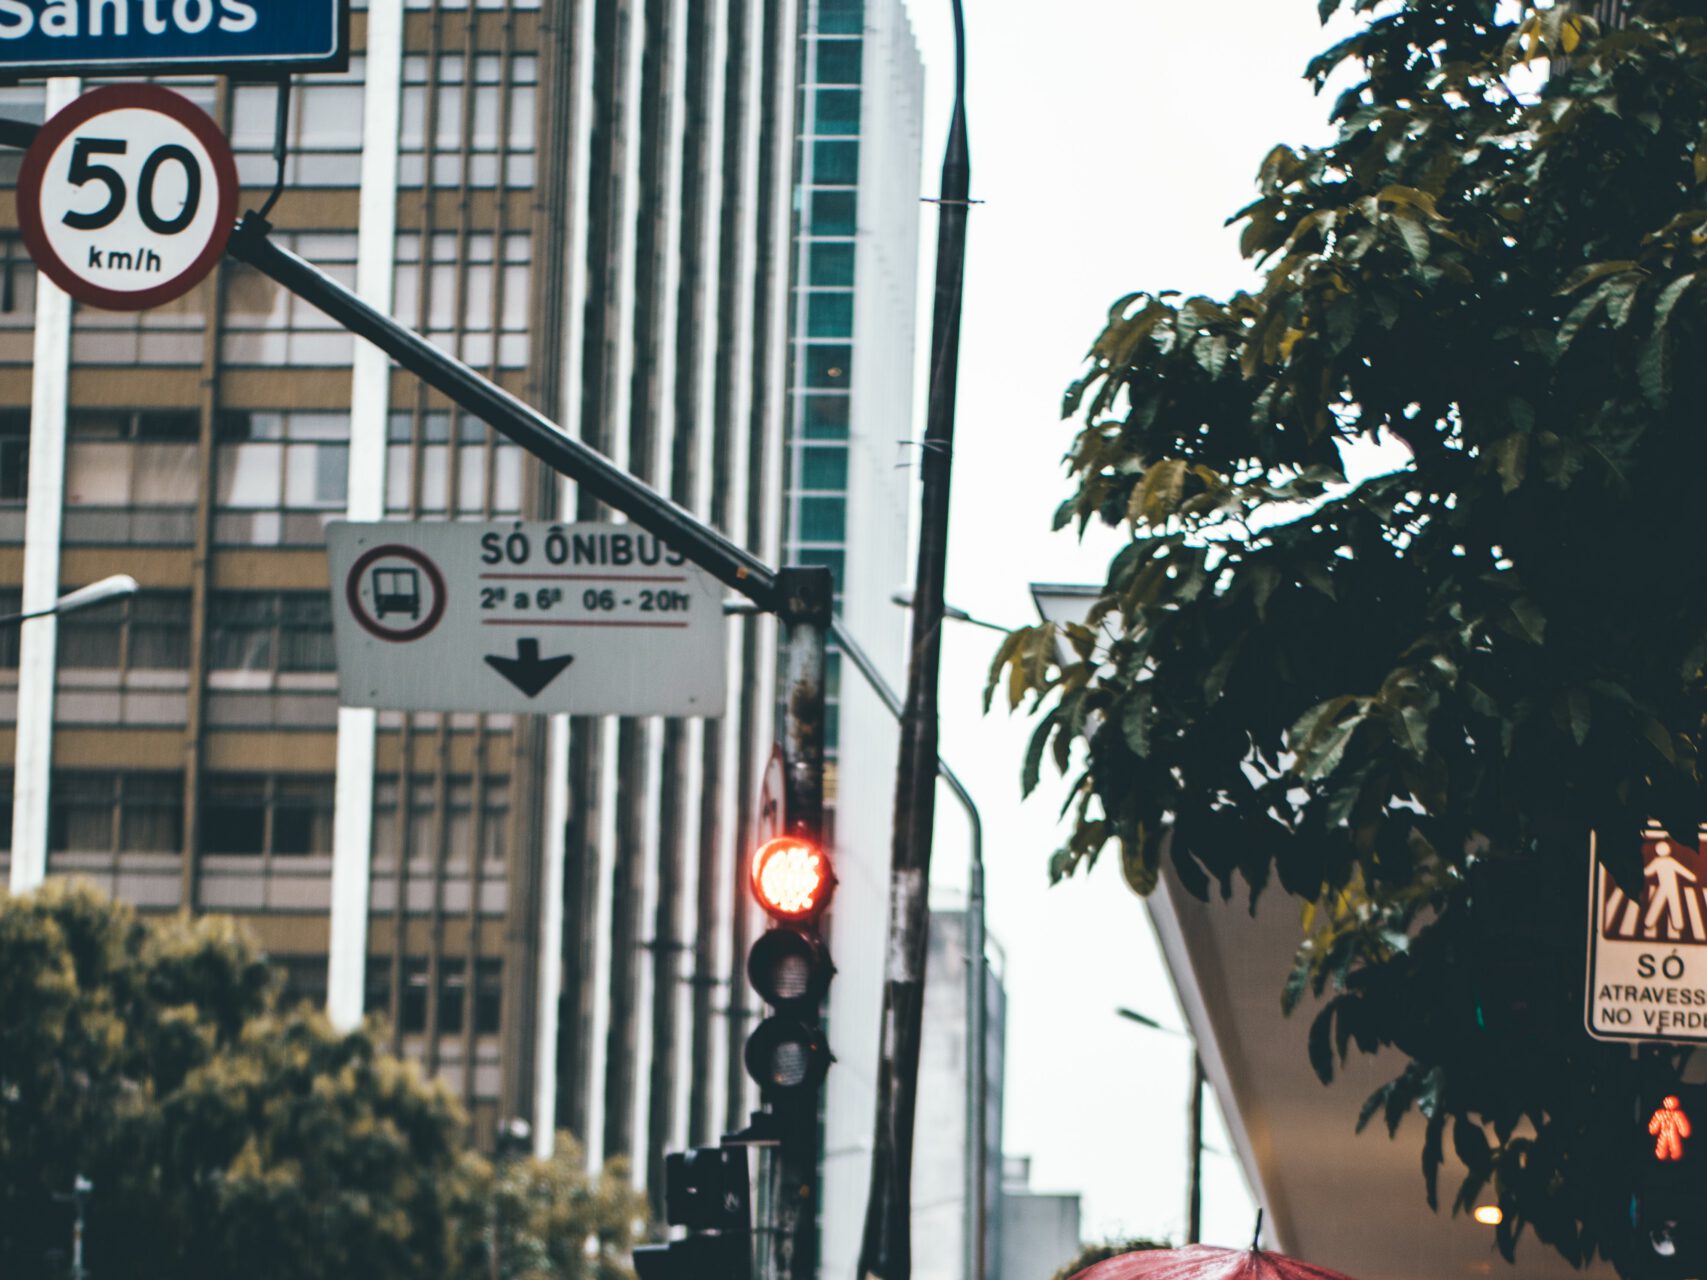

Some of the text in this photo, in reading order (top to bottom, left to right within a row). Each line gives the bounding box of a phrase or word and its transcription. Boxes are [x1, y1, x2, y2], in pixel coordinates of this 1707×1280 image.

[0, 0, 258, 39] Santos
[61, 137, 202, 235] 50
[88, 245, 162, 272] km/h
[481, 521, 531, 565] SÓ
[513, 592, 530, 610] a
[1637, 948, 1684, 980] SÓ
[1602, 1007, 1632, 1025] NO
